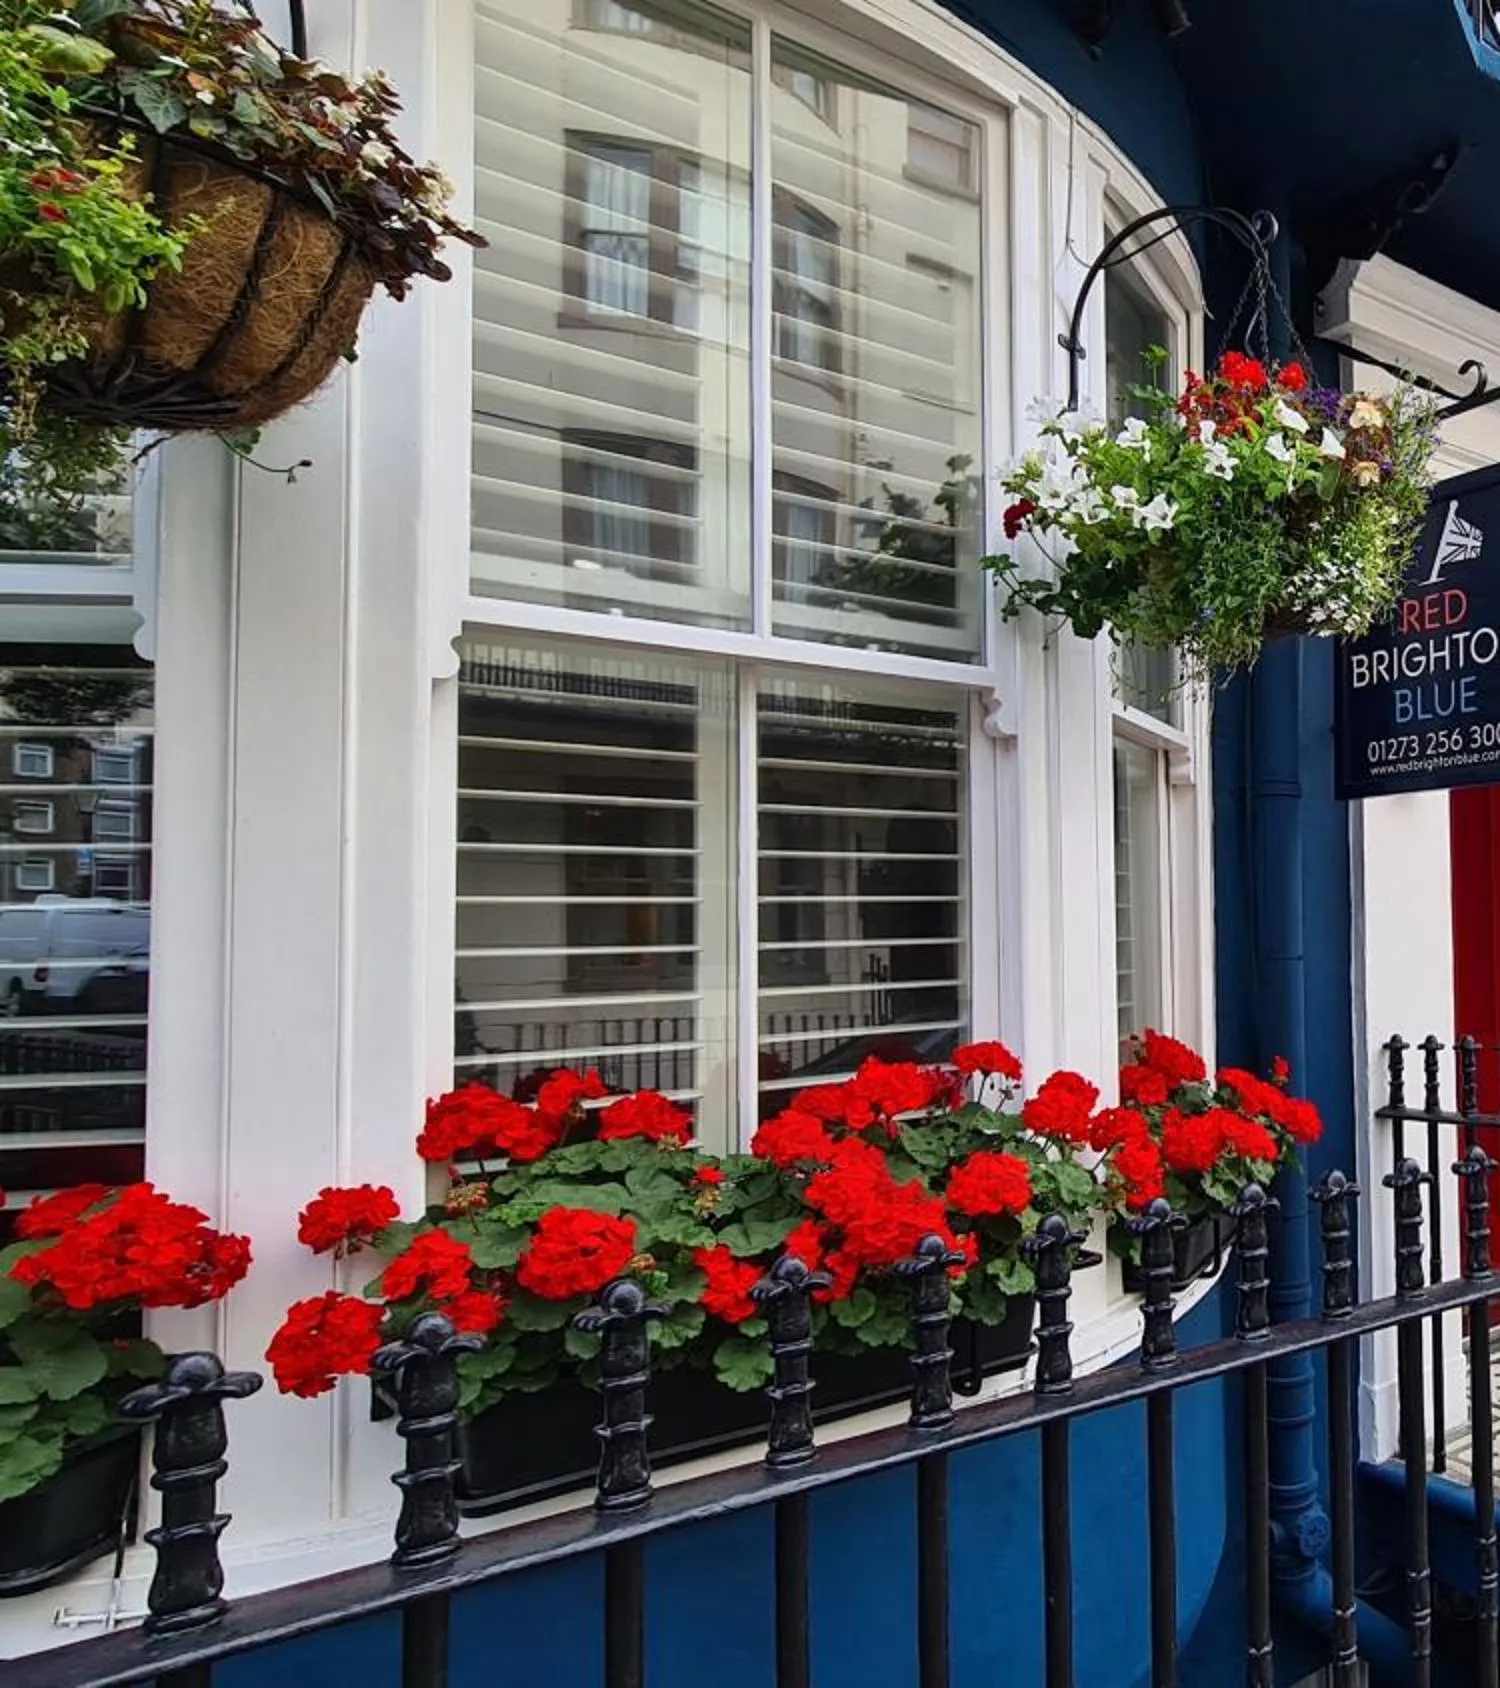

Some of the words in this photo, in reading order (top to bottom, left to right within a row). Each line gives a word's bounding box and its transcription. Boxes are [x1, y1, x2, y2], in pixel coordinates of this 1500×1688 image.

[1402, 589, 1467, 636] RED
[1394, 675, 1479, 723] BLUE
[1367, 735, 1420, 763] 01273
[1425, 728, 1463, 755] 256
